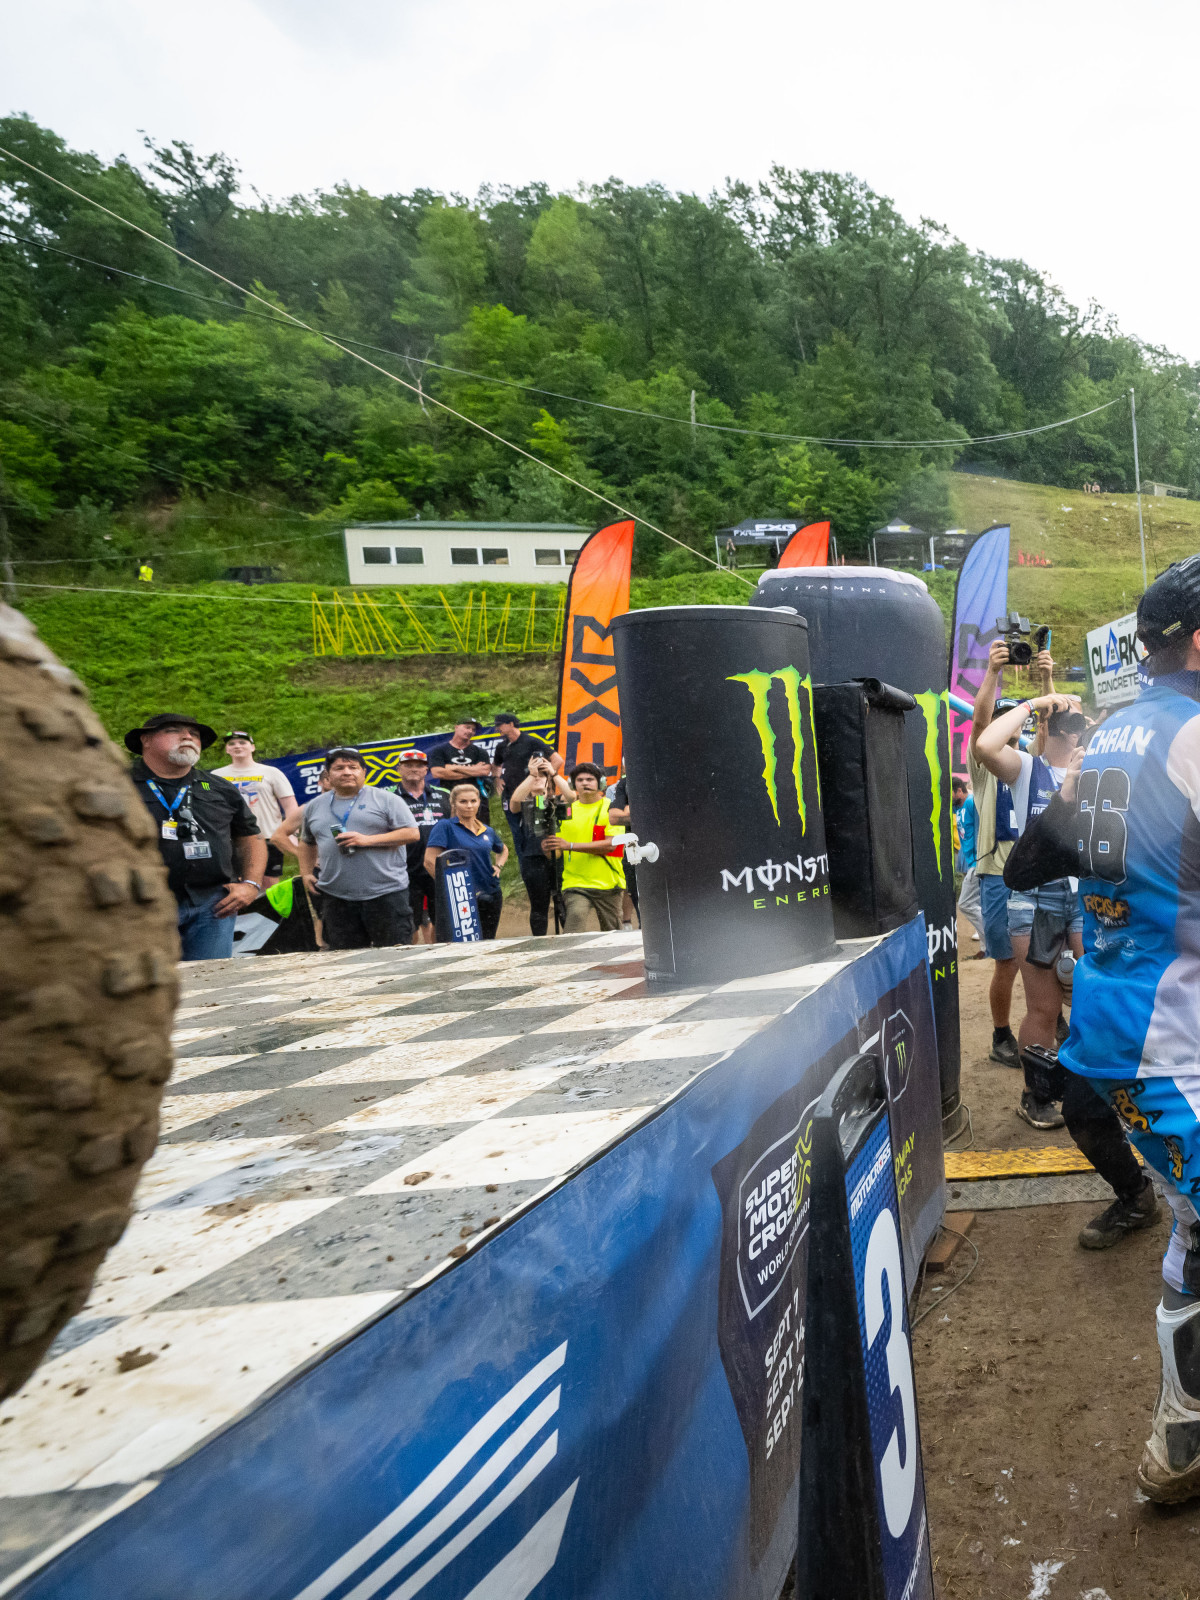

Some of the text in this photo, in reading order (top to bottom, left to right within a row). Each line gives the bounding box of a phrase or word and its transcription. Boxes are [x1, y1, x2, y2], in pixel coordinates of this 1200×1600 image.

[780, 584, 886, 594] VITAMINS
[1091, 630, 1141, 677] CLARK
[1097, 672, 1140, 695] CONCRETE
[753, 883, 831, 910] ENERG
[745, 1150, 799, 1219] SUPER
[750, 1173, 798, 1238] MOTO
[850, 1143, 891, 1221] MOTOCROSS
[749, 1197, 798, 1262] CROSS
[757, 1243, 789, 1287] WORLD
[764, 1287, 799, 1379] SEPT 7
[766, 1341, 794, 1419] SEPT
[864, 1207, 917, 1538] 3
[766, 1378, 795, 1461] SEPT
